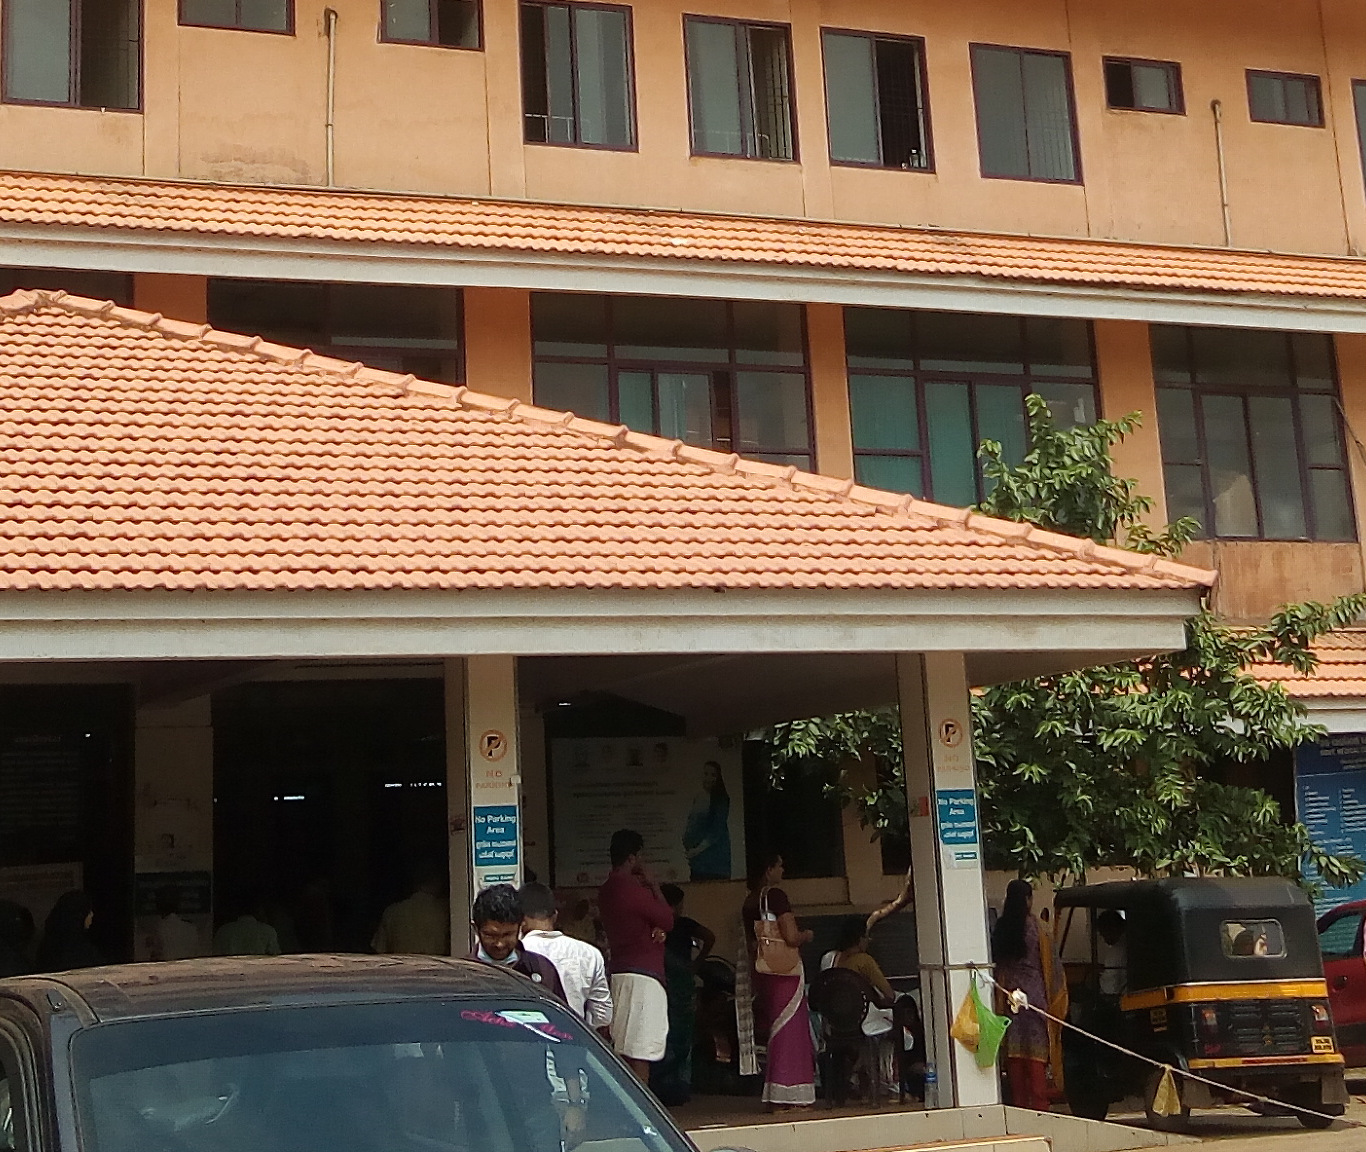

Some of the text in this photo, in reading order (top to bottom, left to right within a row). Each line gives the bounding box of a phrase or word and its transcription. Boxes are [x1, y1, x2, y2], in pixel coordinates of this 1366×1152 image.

[475, 814, 516, 824] No Parking
[486, 826, 505, 834] Area
